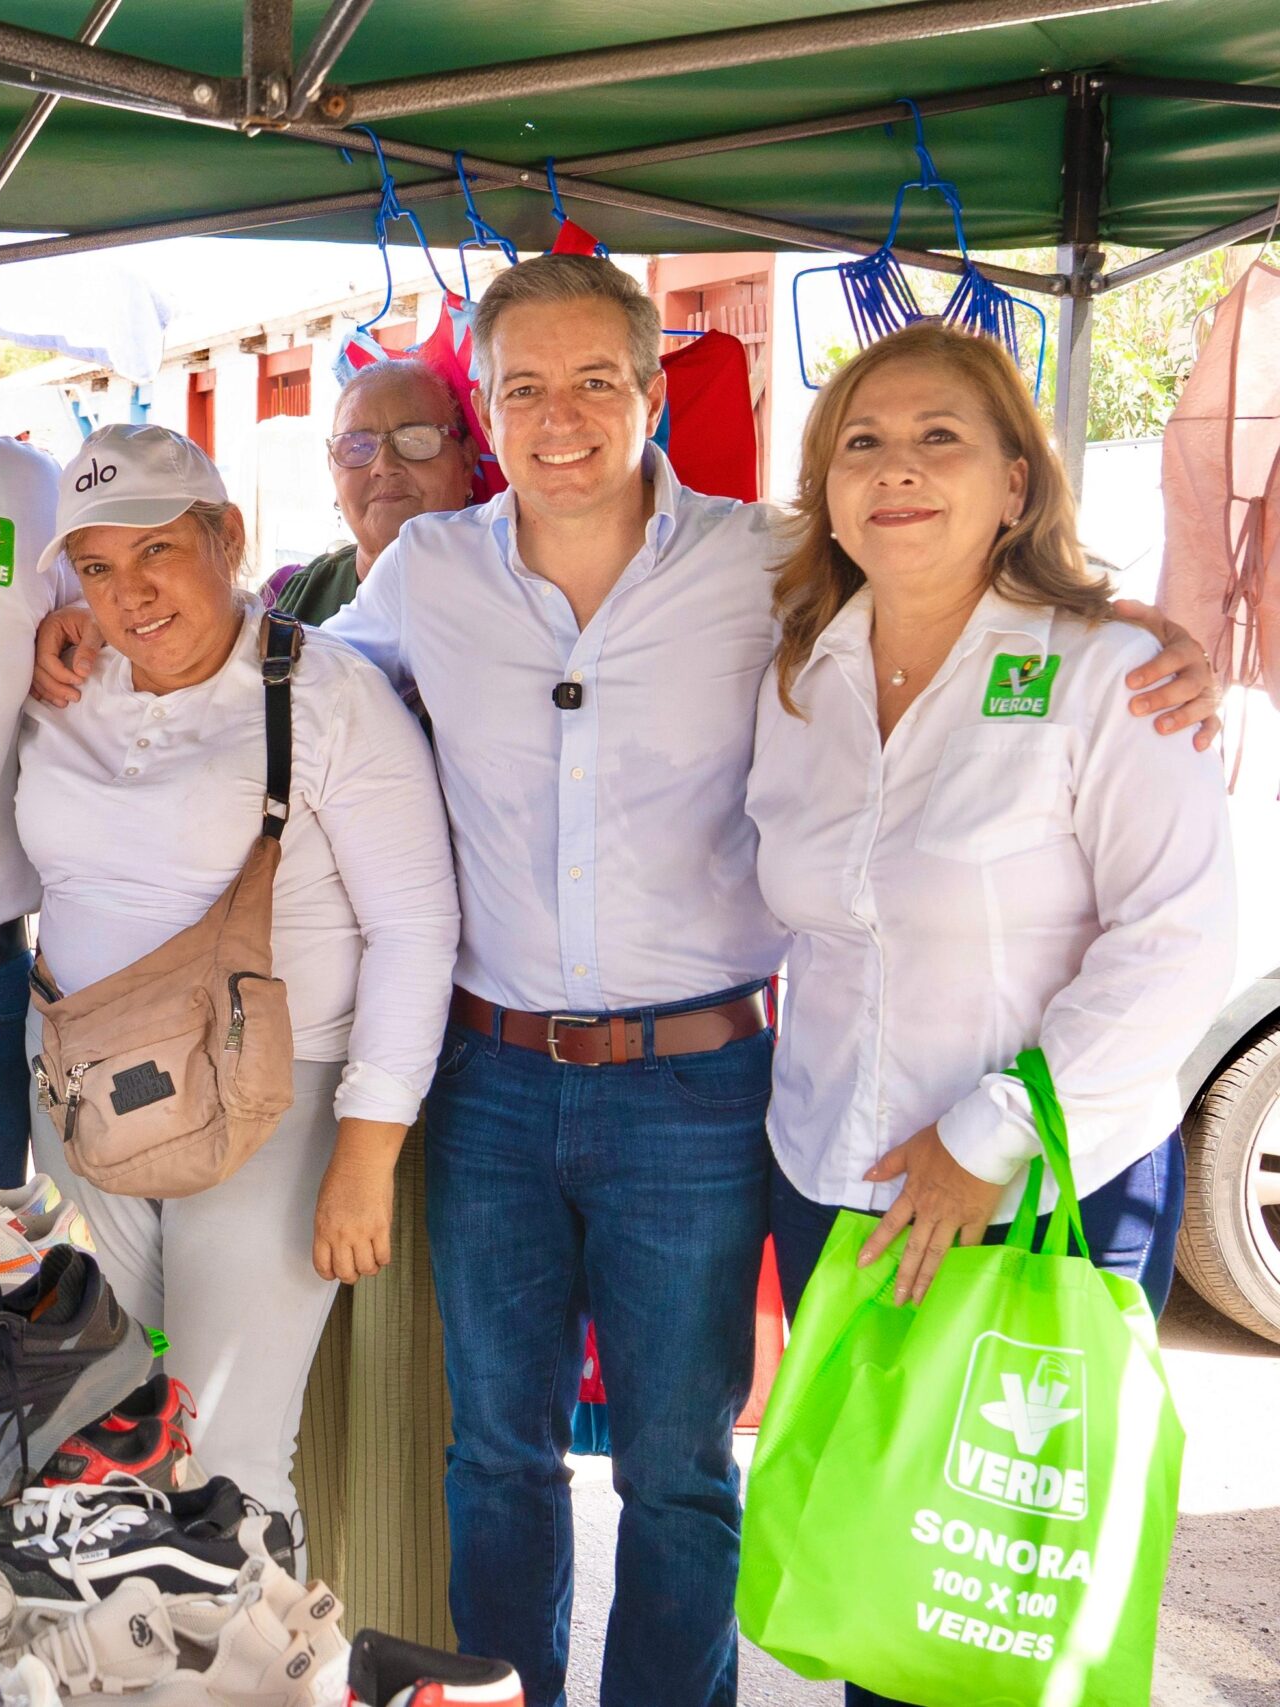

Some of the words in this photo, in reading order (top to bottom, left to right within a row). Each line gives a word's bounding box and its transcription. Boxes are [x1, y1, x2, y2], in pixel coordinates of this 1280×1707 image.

[75, 458, 117, 493] alo
[989, 697, 1045, 713] VERDE
[958, 1440, 1087, 1514] VERDE
[911, 1508, 1093, 1584] SONORA
[932, 1567, 982, 1602] 100
[984, 1582, 1012, 1614] X
[1016, 1591, 1058, 1619] 100
[916, 1602, 1055, 1661] VERDES
